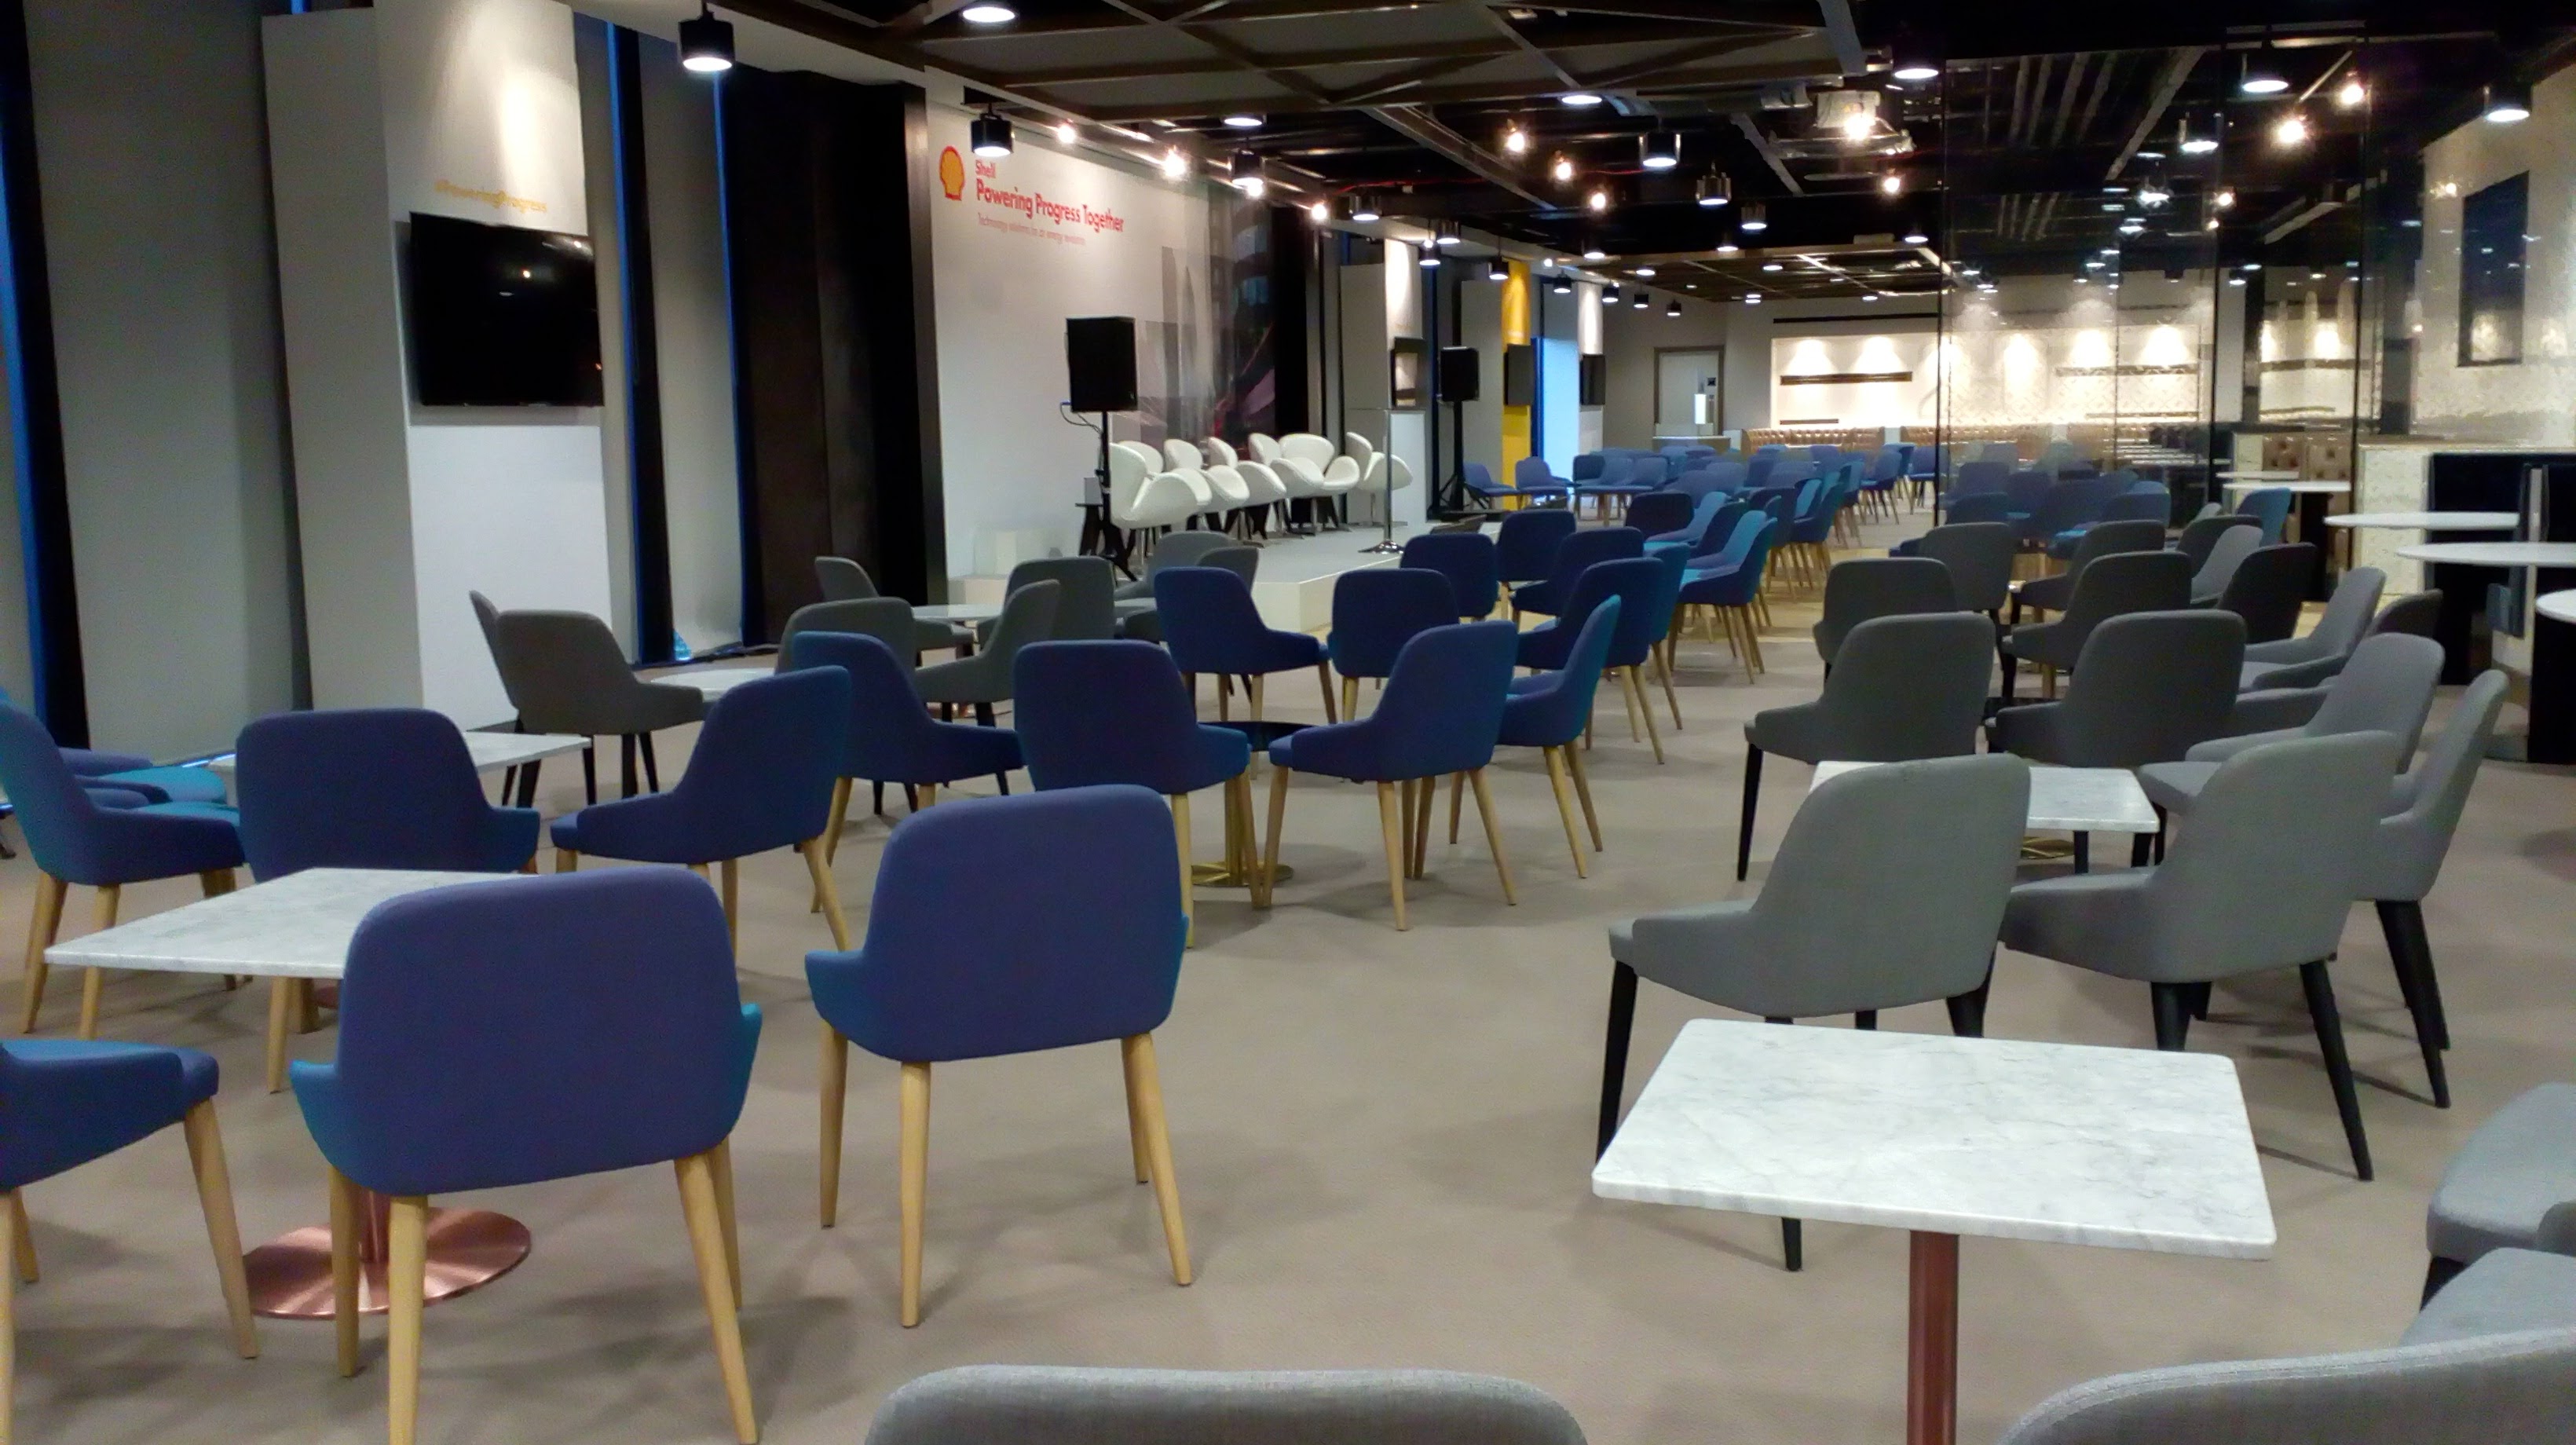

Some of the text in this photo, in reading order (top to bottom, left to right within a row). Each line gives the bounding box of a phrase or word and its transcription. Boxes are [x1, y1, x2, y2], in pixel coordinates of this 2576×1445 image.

[975, 159, 996, 178] Shell
[976, 178, 1125, 233] Powering Progress Together
